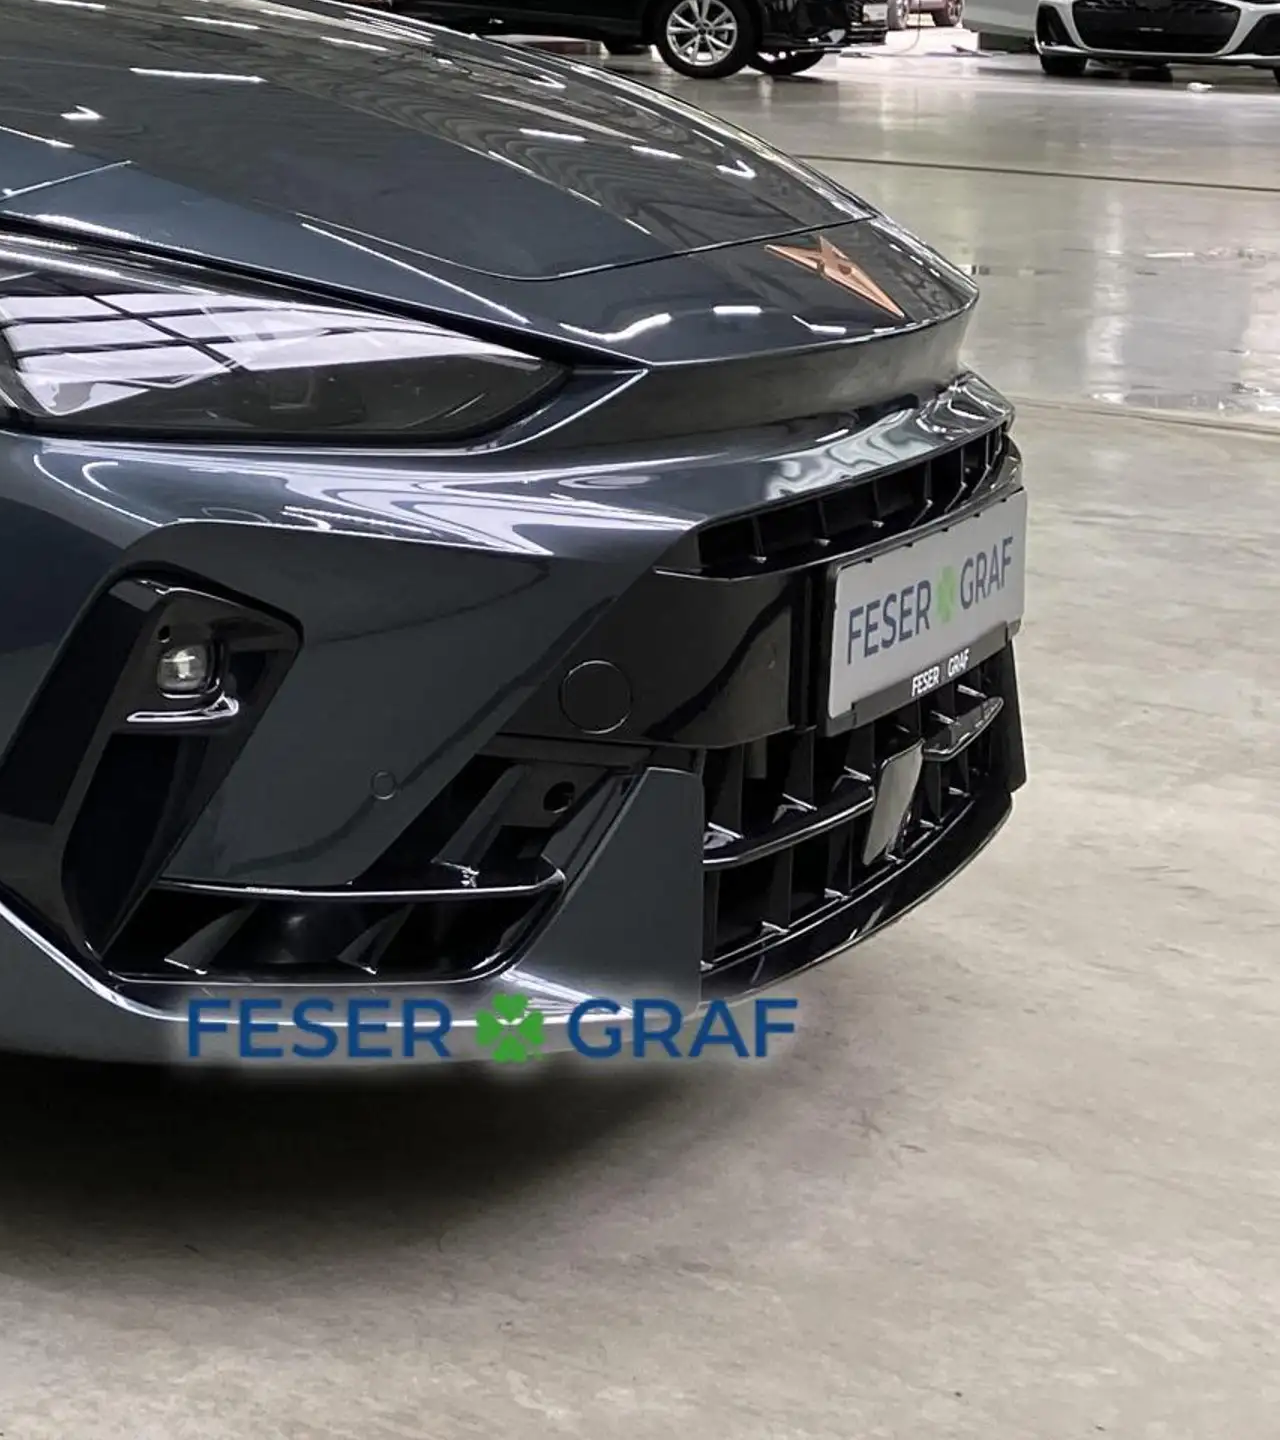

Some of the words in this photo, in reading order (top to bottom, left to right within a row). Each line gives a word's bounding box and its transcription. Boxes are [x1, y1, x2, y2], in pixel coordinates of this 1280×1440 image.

[847, 579, 933, 665] FESER
[959, 536, 1015, 610] GRAF
[911, 665, 940, 697] FESER
[947, 648, 971, 678] GRAF
